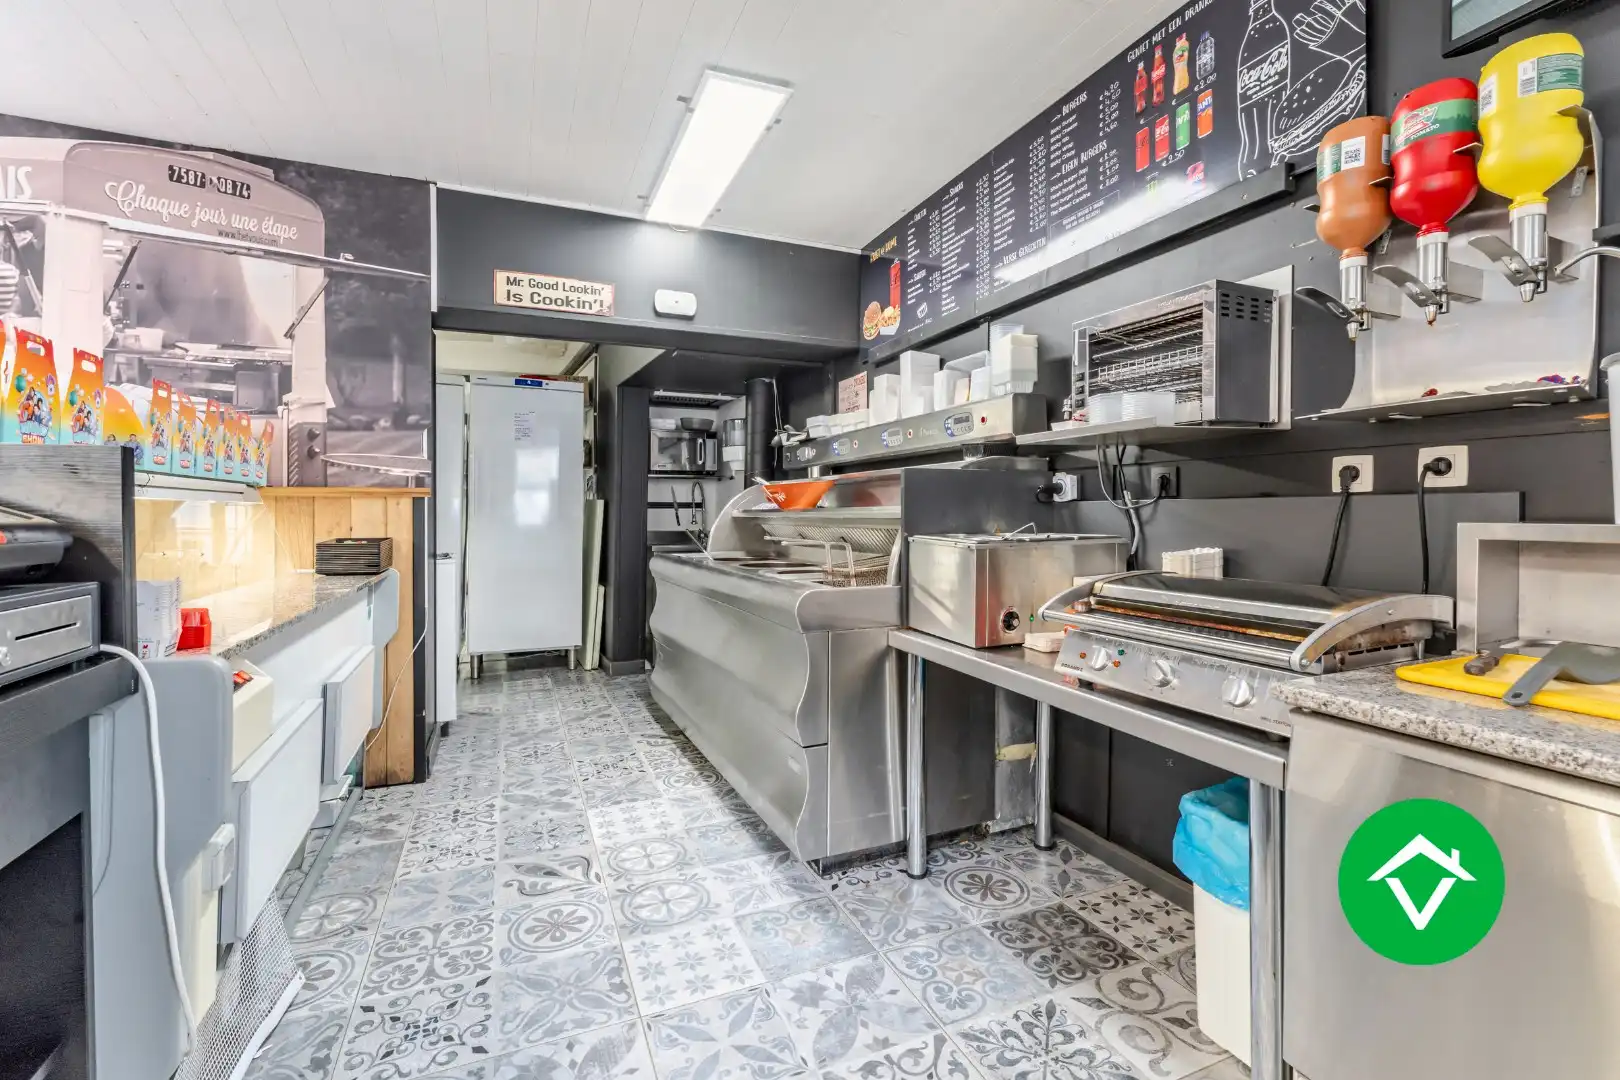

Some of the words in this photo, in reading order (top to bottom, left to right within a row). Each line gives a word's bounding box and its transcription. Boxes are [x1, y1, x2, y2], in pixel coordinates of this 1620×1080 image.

[1127, 39, 1150, 63] GENIET
[1152, 27, 1166, 45] MET
[1168, 16, 1182, 33] EEN
[1239, 45, 1288, 88] Coca-Cola
[1063, 91, 1088, 116] BURGERS
[1410, 124, 1440, 140] TOMATO
[1081, 140, 1107, 163] BURGERS
[235, 182, 249, 198] 74
[105, 180, 192, 223] Chaque
[191, 202, 229, 228] jour
[230, 213, 259, 232] une
[261, 216, 298, 243] étape
[506, 275, 524, 288] Mr.
[528, 278, 559, 291] Good
[562, 281, 605, 297] Lookin'
[506, 289, 524, 303] Is
